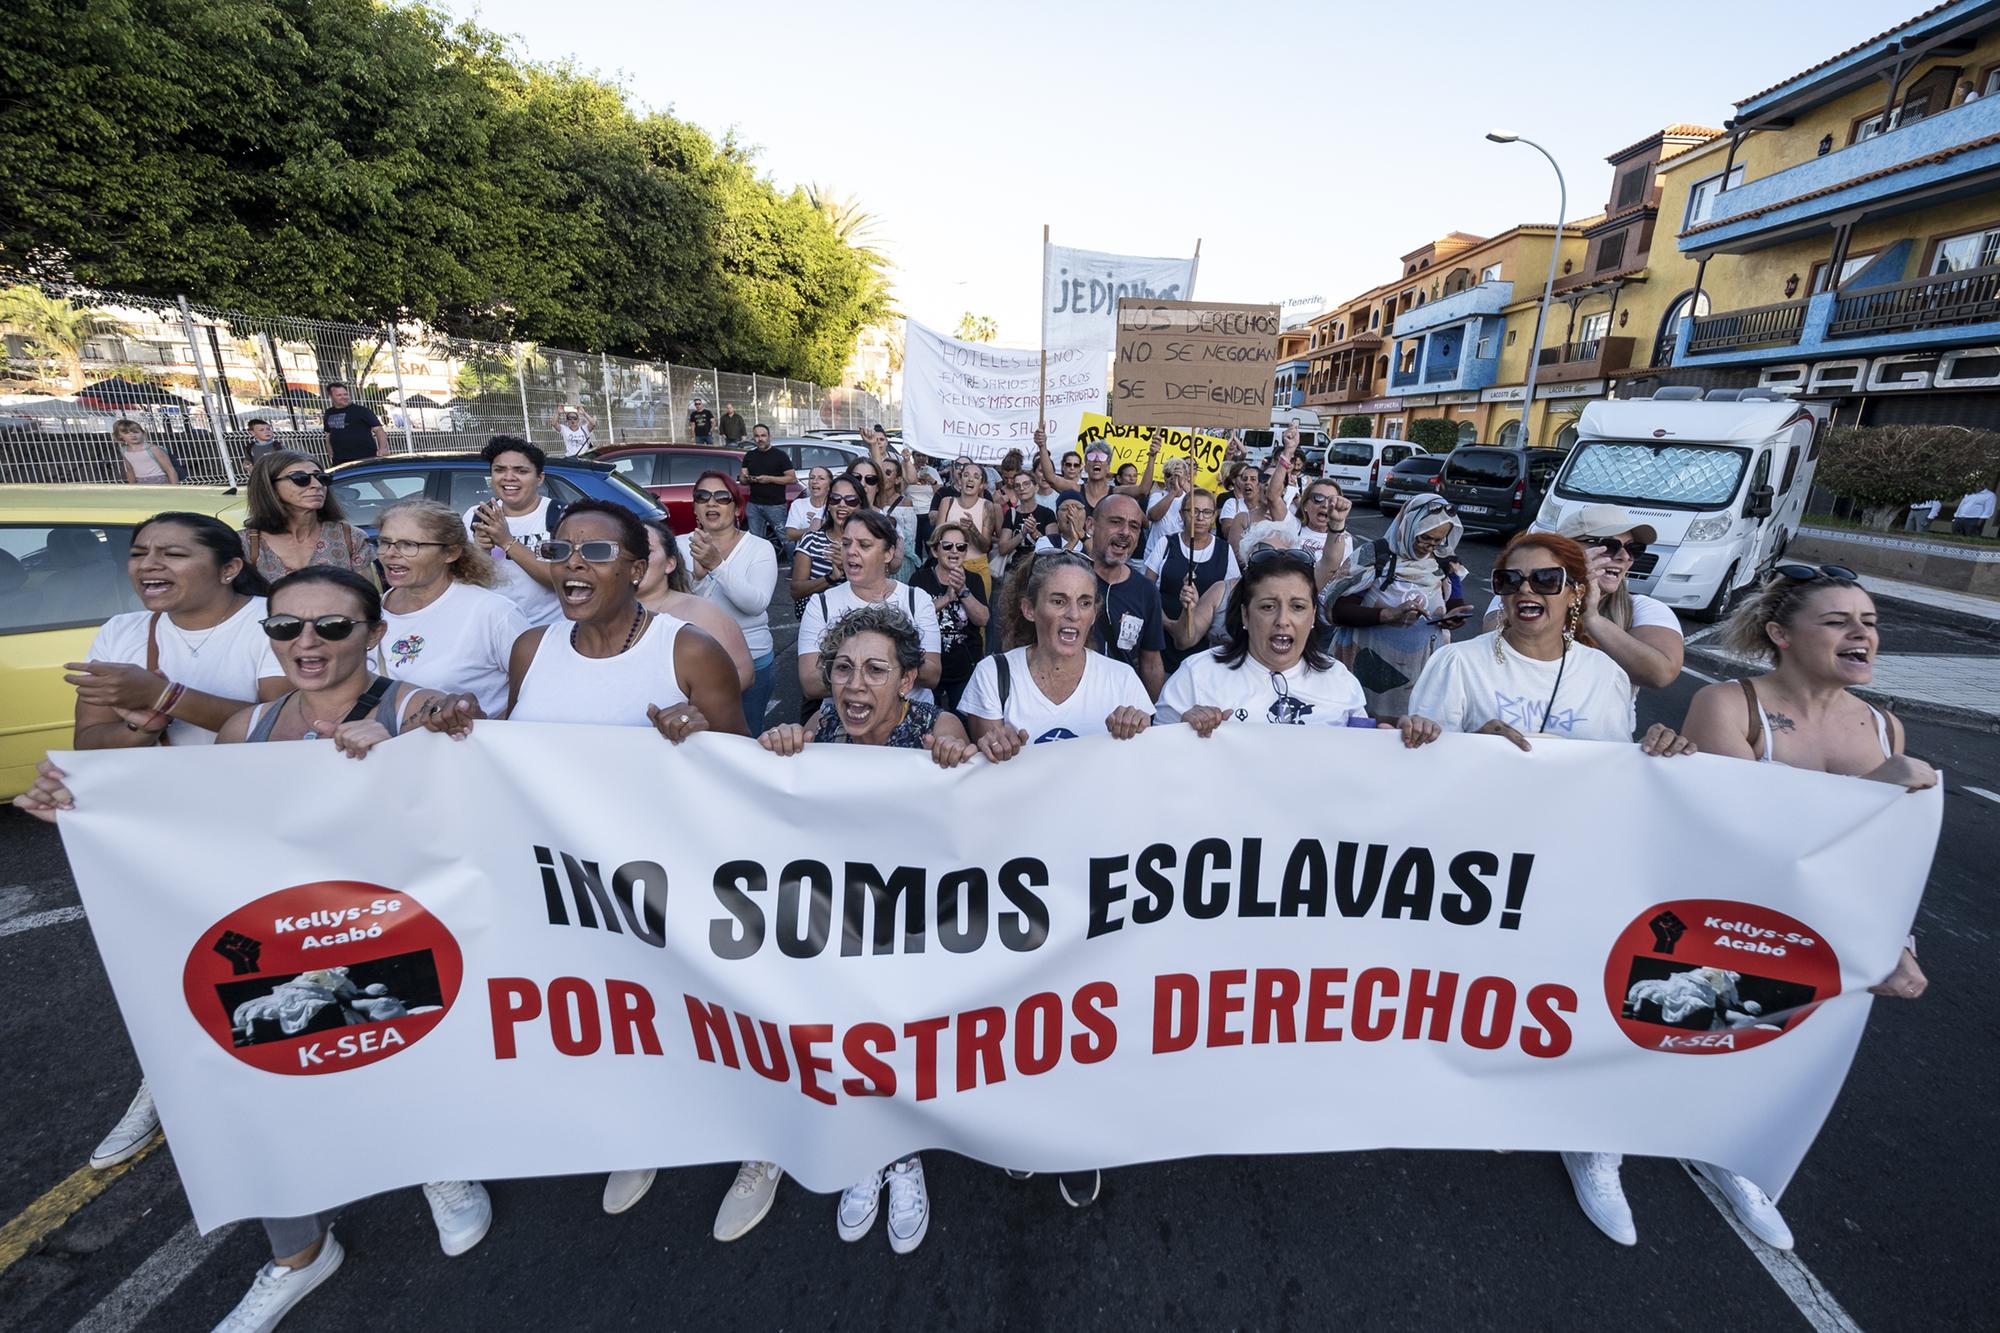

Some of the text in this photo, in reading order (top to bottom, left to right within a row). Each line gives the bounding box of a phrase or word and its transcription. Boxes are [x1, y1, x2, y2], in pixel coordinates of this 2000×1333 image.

[1122, 303, 1279, 335] LOS DERECHOS
[1120, 341, 1152, 363] NO
[1165, 342, 1194, 362] SE
[400, 362, 430, 376] SPA
[1032, 377, 1056, 388] MS
[1059, 372, 1091, 387] RICOS
[1117, 379, 1147, 400] SE
[1490, 391, 1509, 399] LACOSTE
[1549, 385, 1572, 394] LACOSTE
[943, 419, 1058, 437] MENOS SALD
[959, 442, 1008, 461] HUELG
[1078, 421, 1223, 473] TRABAJADORAS
[1112, 445, 1133, 460] NO
[708, 856, 1050, 961] SOMOS
[1086, 837, 1535, 940] ESCLAVAS!
[274, 898, 402, 934] Kellys-Se
[301, 922, 383, 950] Acabó
[1703, 916, 1816, 947] Kellys-Se
[1713, 935, 1787, 957] Acabó
[297, 1026, 406, 1068] K-SEA
[486, 967, 1578, 1106] POR NUESTROS DERECHOS
[1659, 1033, 1736, 1049] K-SEA
